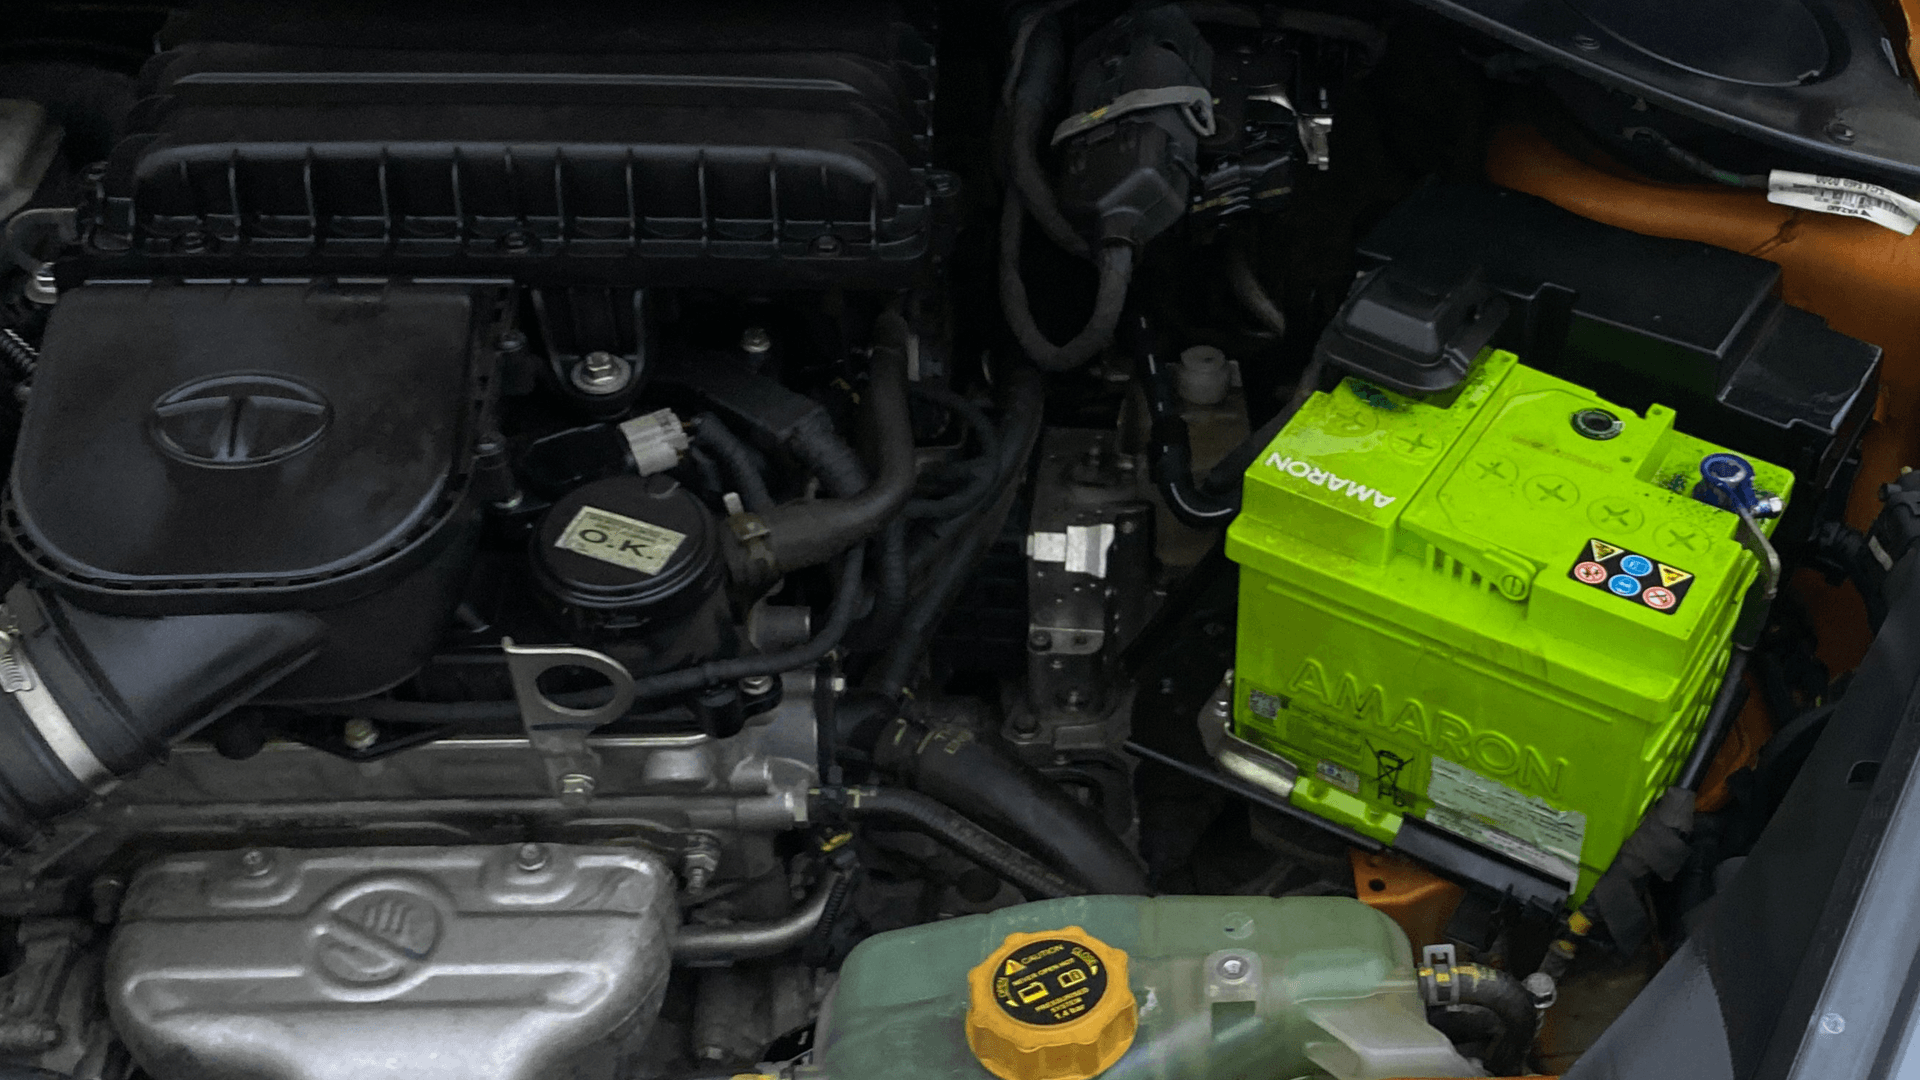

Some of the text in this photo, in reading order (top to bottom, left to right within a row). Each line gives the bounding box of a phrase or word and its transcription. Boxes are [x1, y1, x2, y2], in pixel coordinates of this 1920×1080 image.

[1265, 451, 1397, 508] AMARON
[579, 529, 653, 559] O.K.
[1288, 658, 1569, 796] AMARON
[1021, 944, 1065, 965] CAUTION
[1012, 957, 1075, 986] NEVER OPEN HOT
[996, 977, 1009, 998] OPEN
[1050, 997, 1082, 1013] SYSTEM
[1054, 1004, 1085, 1019] 1.4 bar
